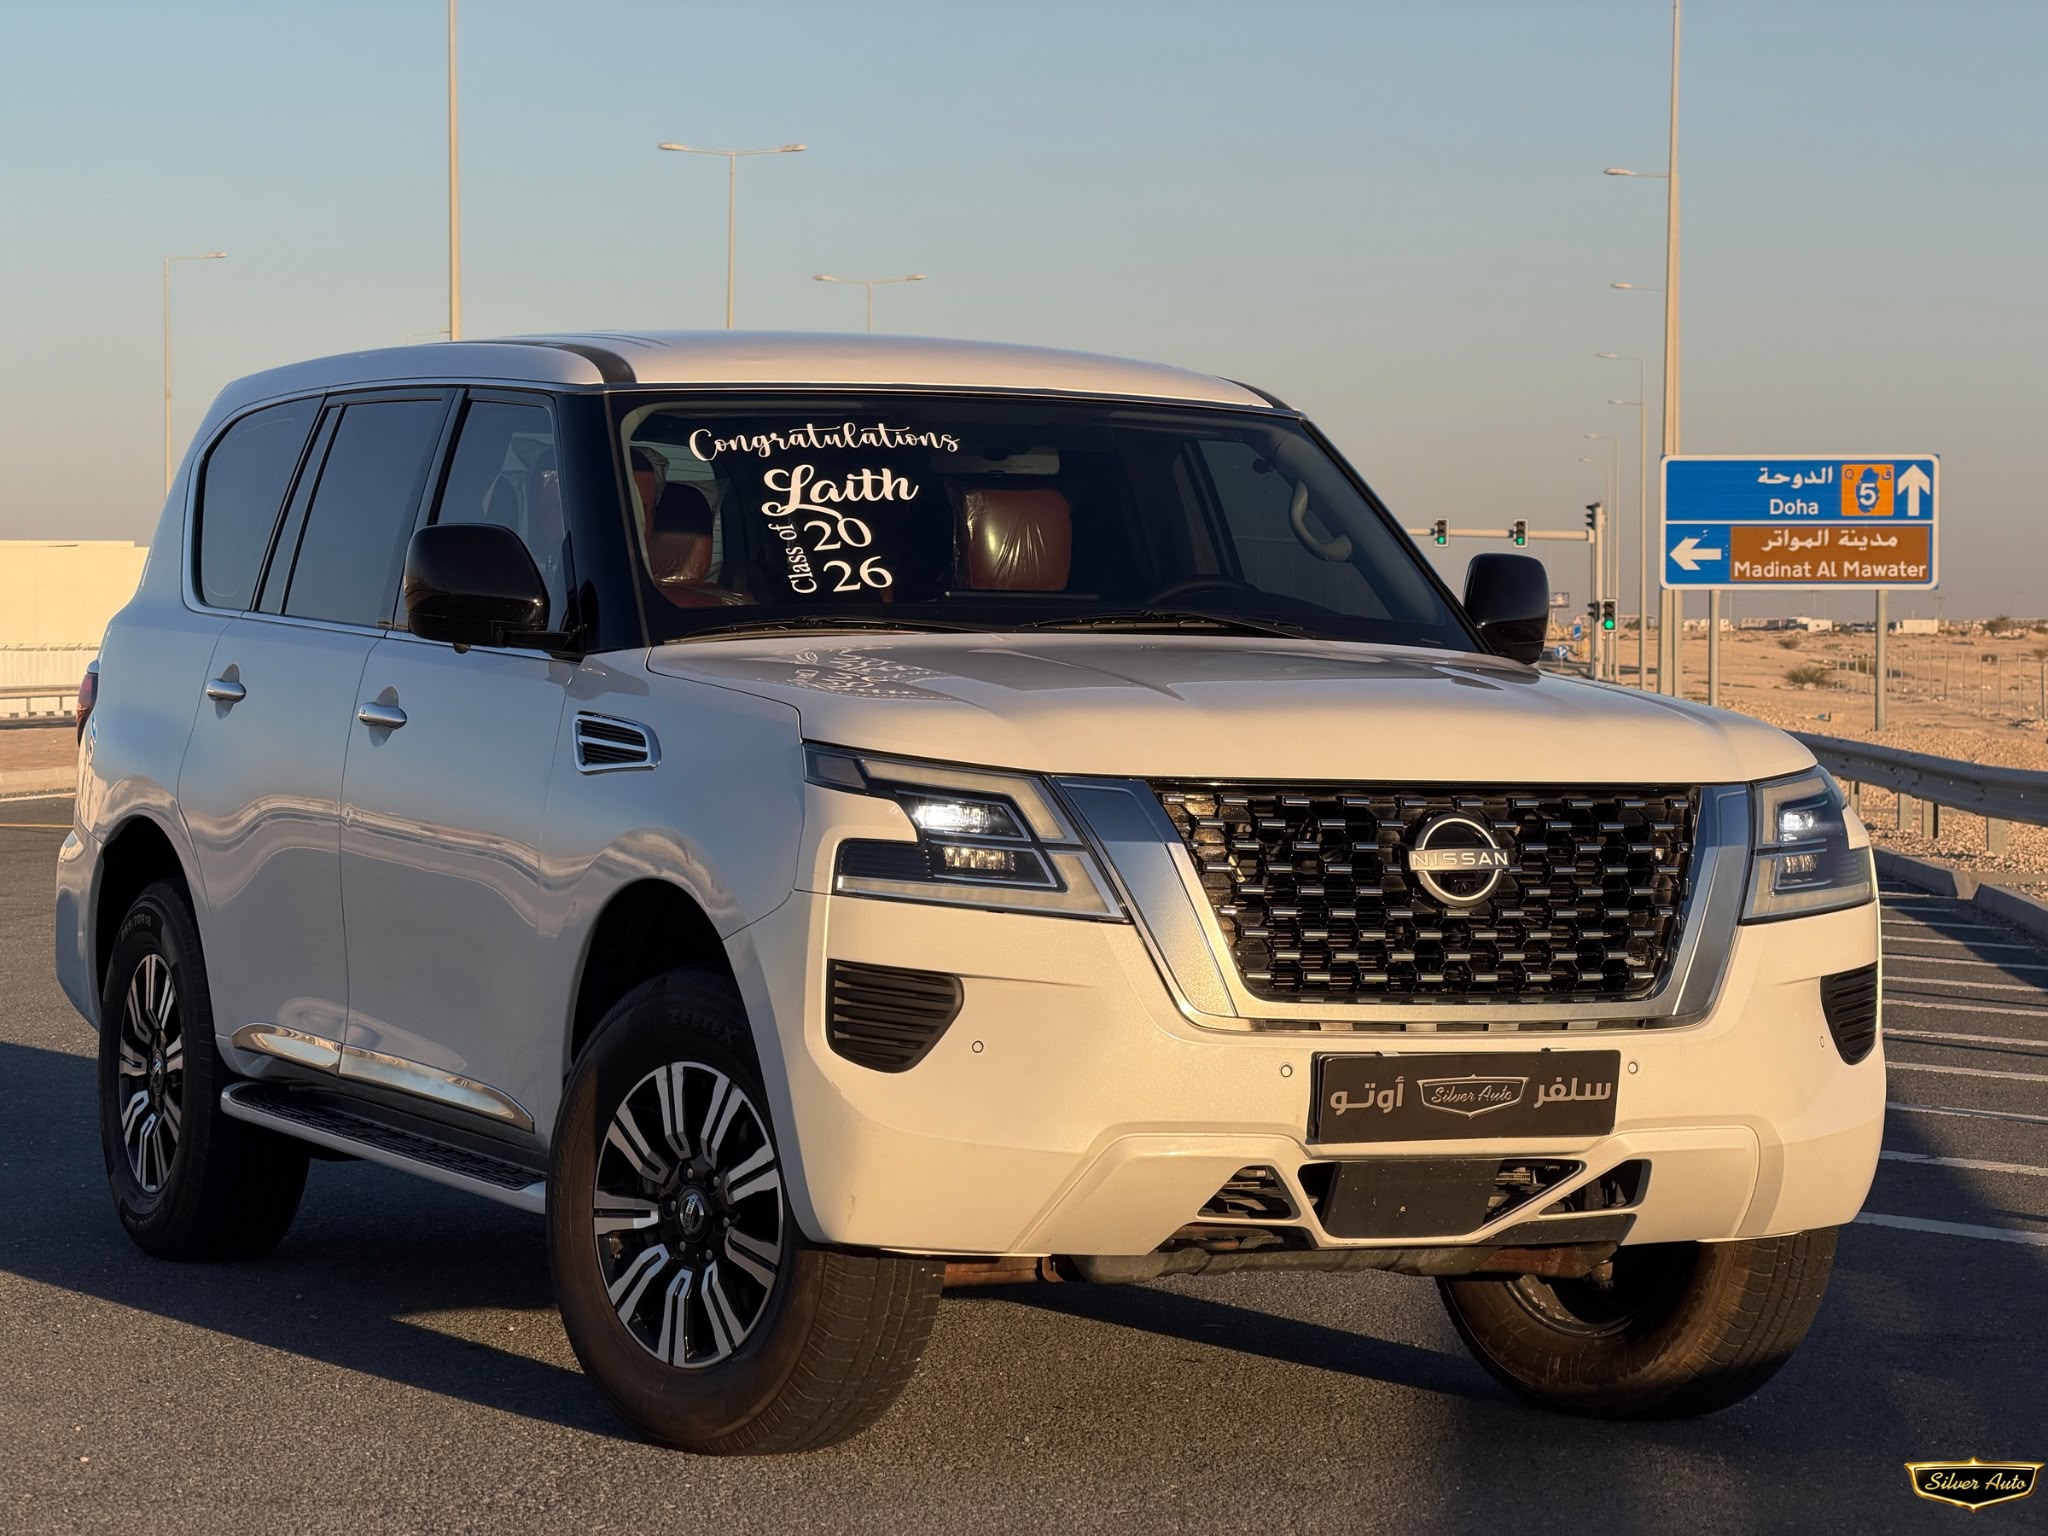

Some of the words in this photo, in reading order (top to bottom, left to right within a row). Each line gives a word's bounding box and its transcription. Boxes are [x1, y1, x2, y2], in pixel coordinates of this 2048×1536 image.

[689, 422, 960, 461] Congratulations
[1757, 465, 1833, 489] الدوحة
[1844, 469, 1855, 480] Q
[761, 464, 919, 517] Laith
[1859, 483, 1877, 505] 5
[1769, 499, 1819, 515] Doha
[768, 522, 797, 541] of
[804, 517, 872, 551] 20
[1761, 528, 1829, 551] المواتر
[1838, 529, 1898, 551] مدينة
[786, 546, 818, 594] Class
[823, 555, 893, 592] 26
[1734, 561, 1811, 578] Madinat
[1816, 561, 1837, 577] Al
[1843, 561, 1927, 578] Mawater
[1411, 852, 1508, 866] NISSAN
[1329, 1076, 1405, 1115] أوتو
[1431, 1086, 1476, 1104] Silver
[1478, 1084, 1513, 1102] Auto
[1533, 1076, 1612, 1108] سلفر
